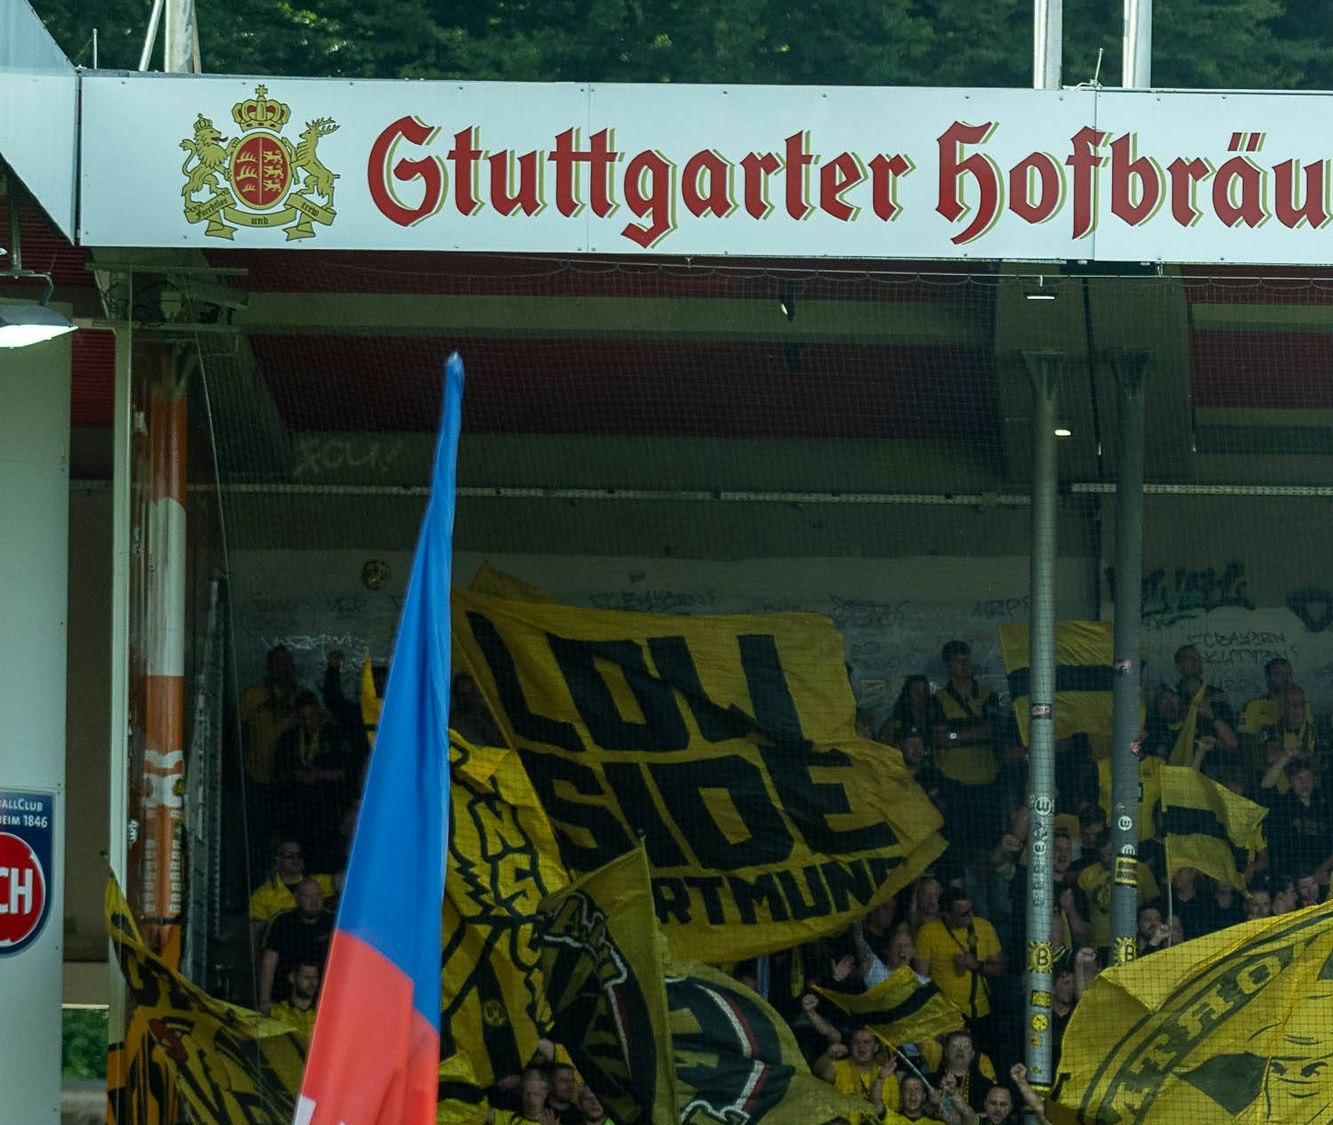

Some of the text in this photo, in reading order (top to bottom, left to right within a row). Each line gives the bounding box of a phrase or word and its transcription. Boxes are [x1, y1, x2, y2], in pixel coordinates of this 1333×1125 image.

[367, 115, 1333, 248] Stuttgarter Hofbräu
[23, 814, 48, 828] 1846
